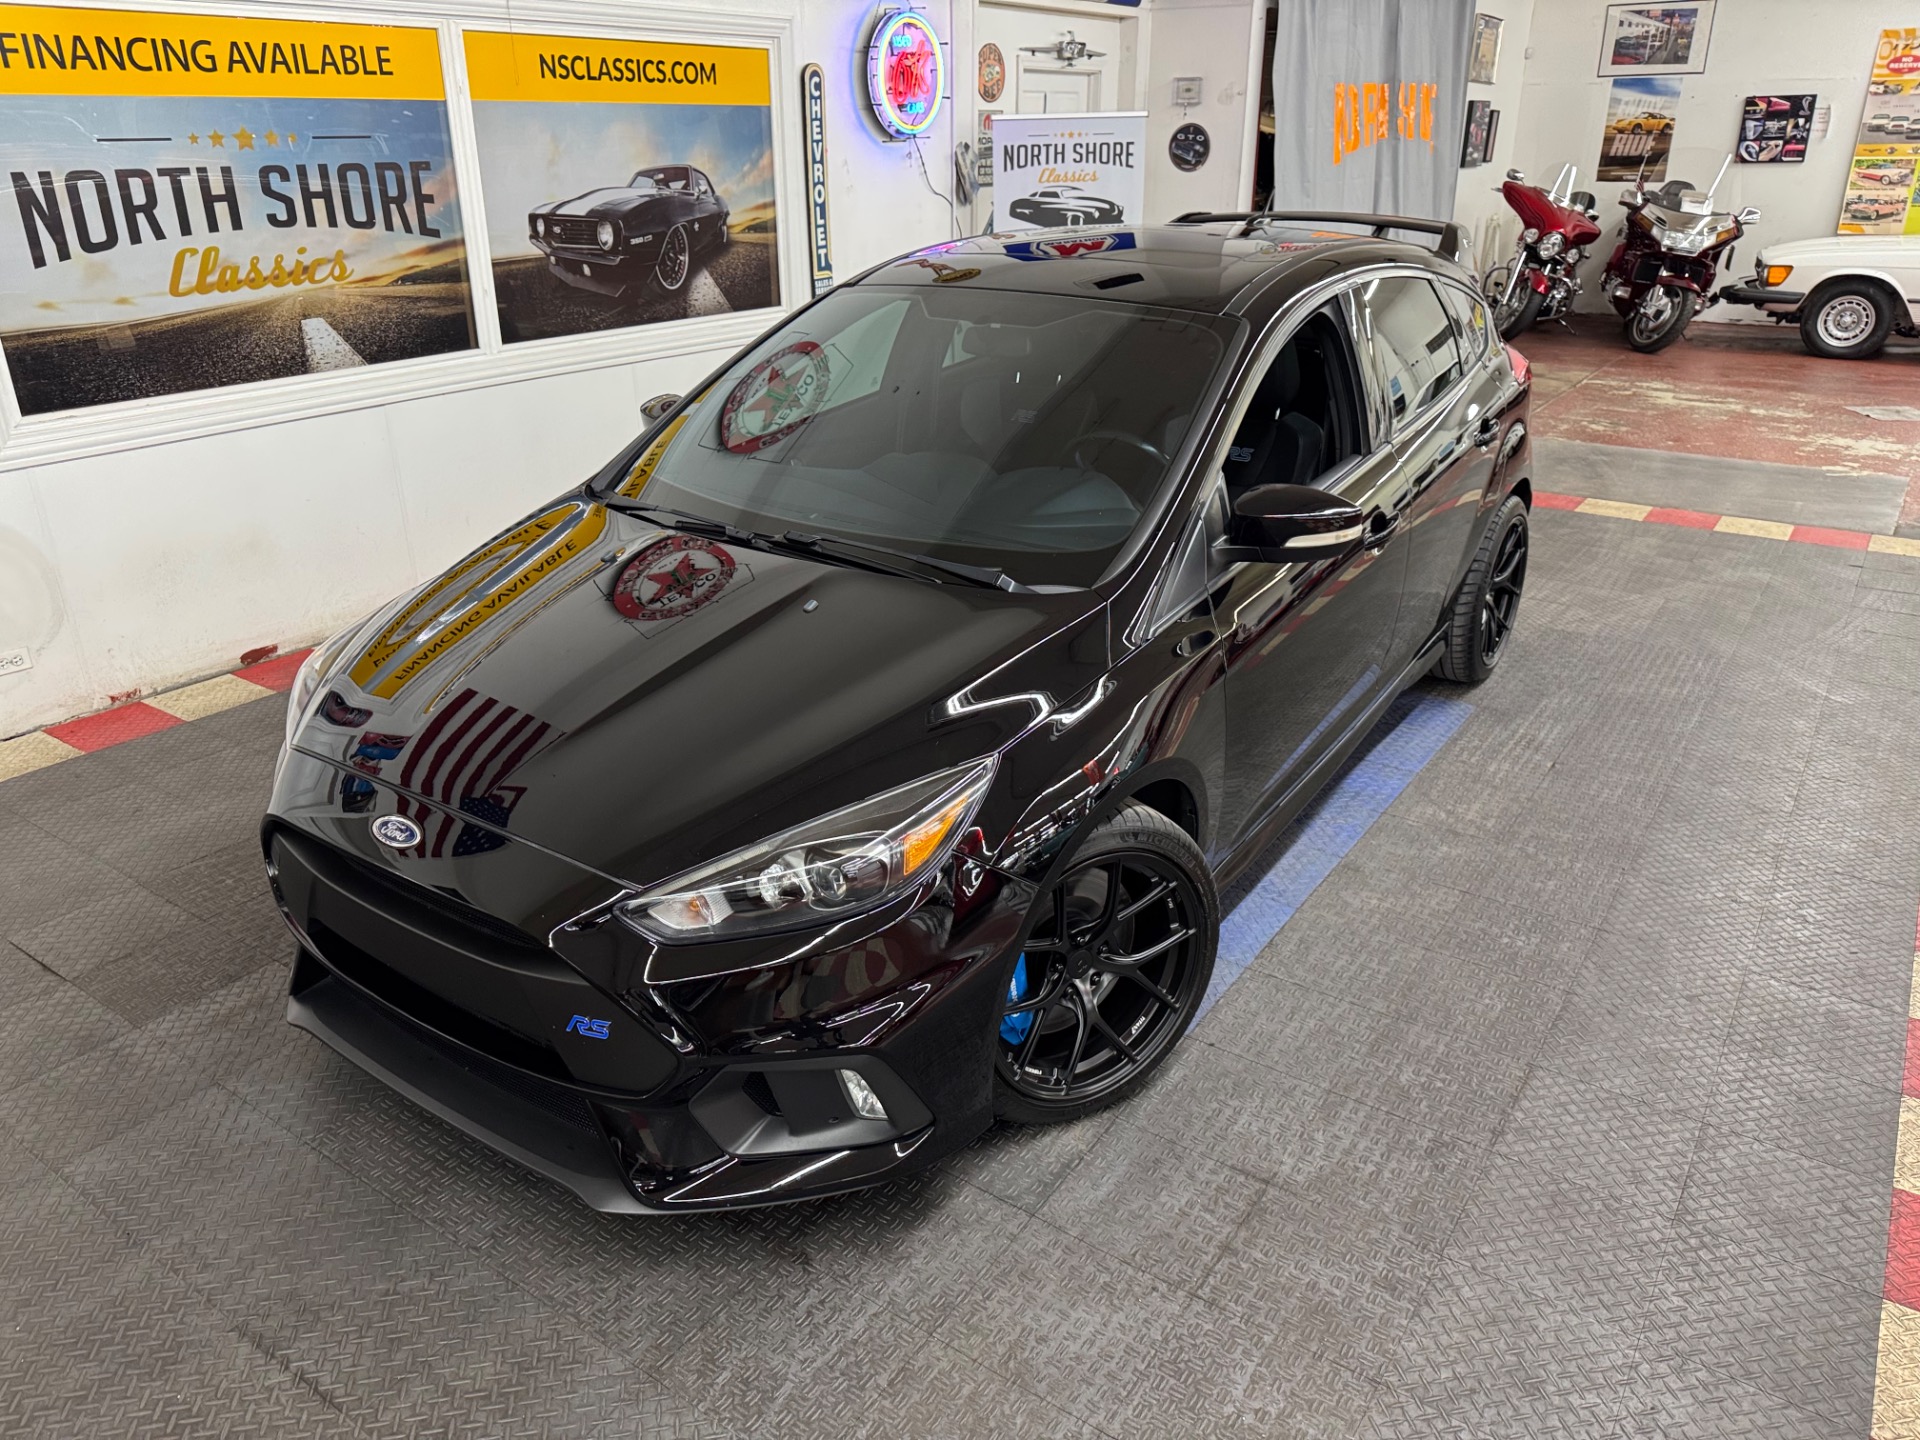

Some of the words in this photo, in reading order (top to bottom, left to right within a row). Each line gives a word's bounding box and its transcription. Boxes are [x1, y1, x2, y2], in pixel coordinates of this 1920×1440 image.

[0, 33, 217, 73] FINANCING
[227, 41, 394, 76] AVAILABLE
[539, 53, 717, 86] NSCLASSICS.COM
[1176, 133, 1205, 142] GTO
[810, 76, 827, 267] CHEVROLET
[1003, 143, 1066, 172] NORTH
[1072, 142, 1135, 169] SHORE
[1038, 167, 1099, 184] Classics
[10, 165, 243, 269] NORTH
[258, 161, 442, 239] SHORE
[169, 245, 355, 298] Classics
[380, 821, 411, 841] Ford
[566, 1014, 612, 1040] RS
